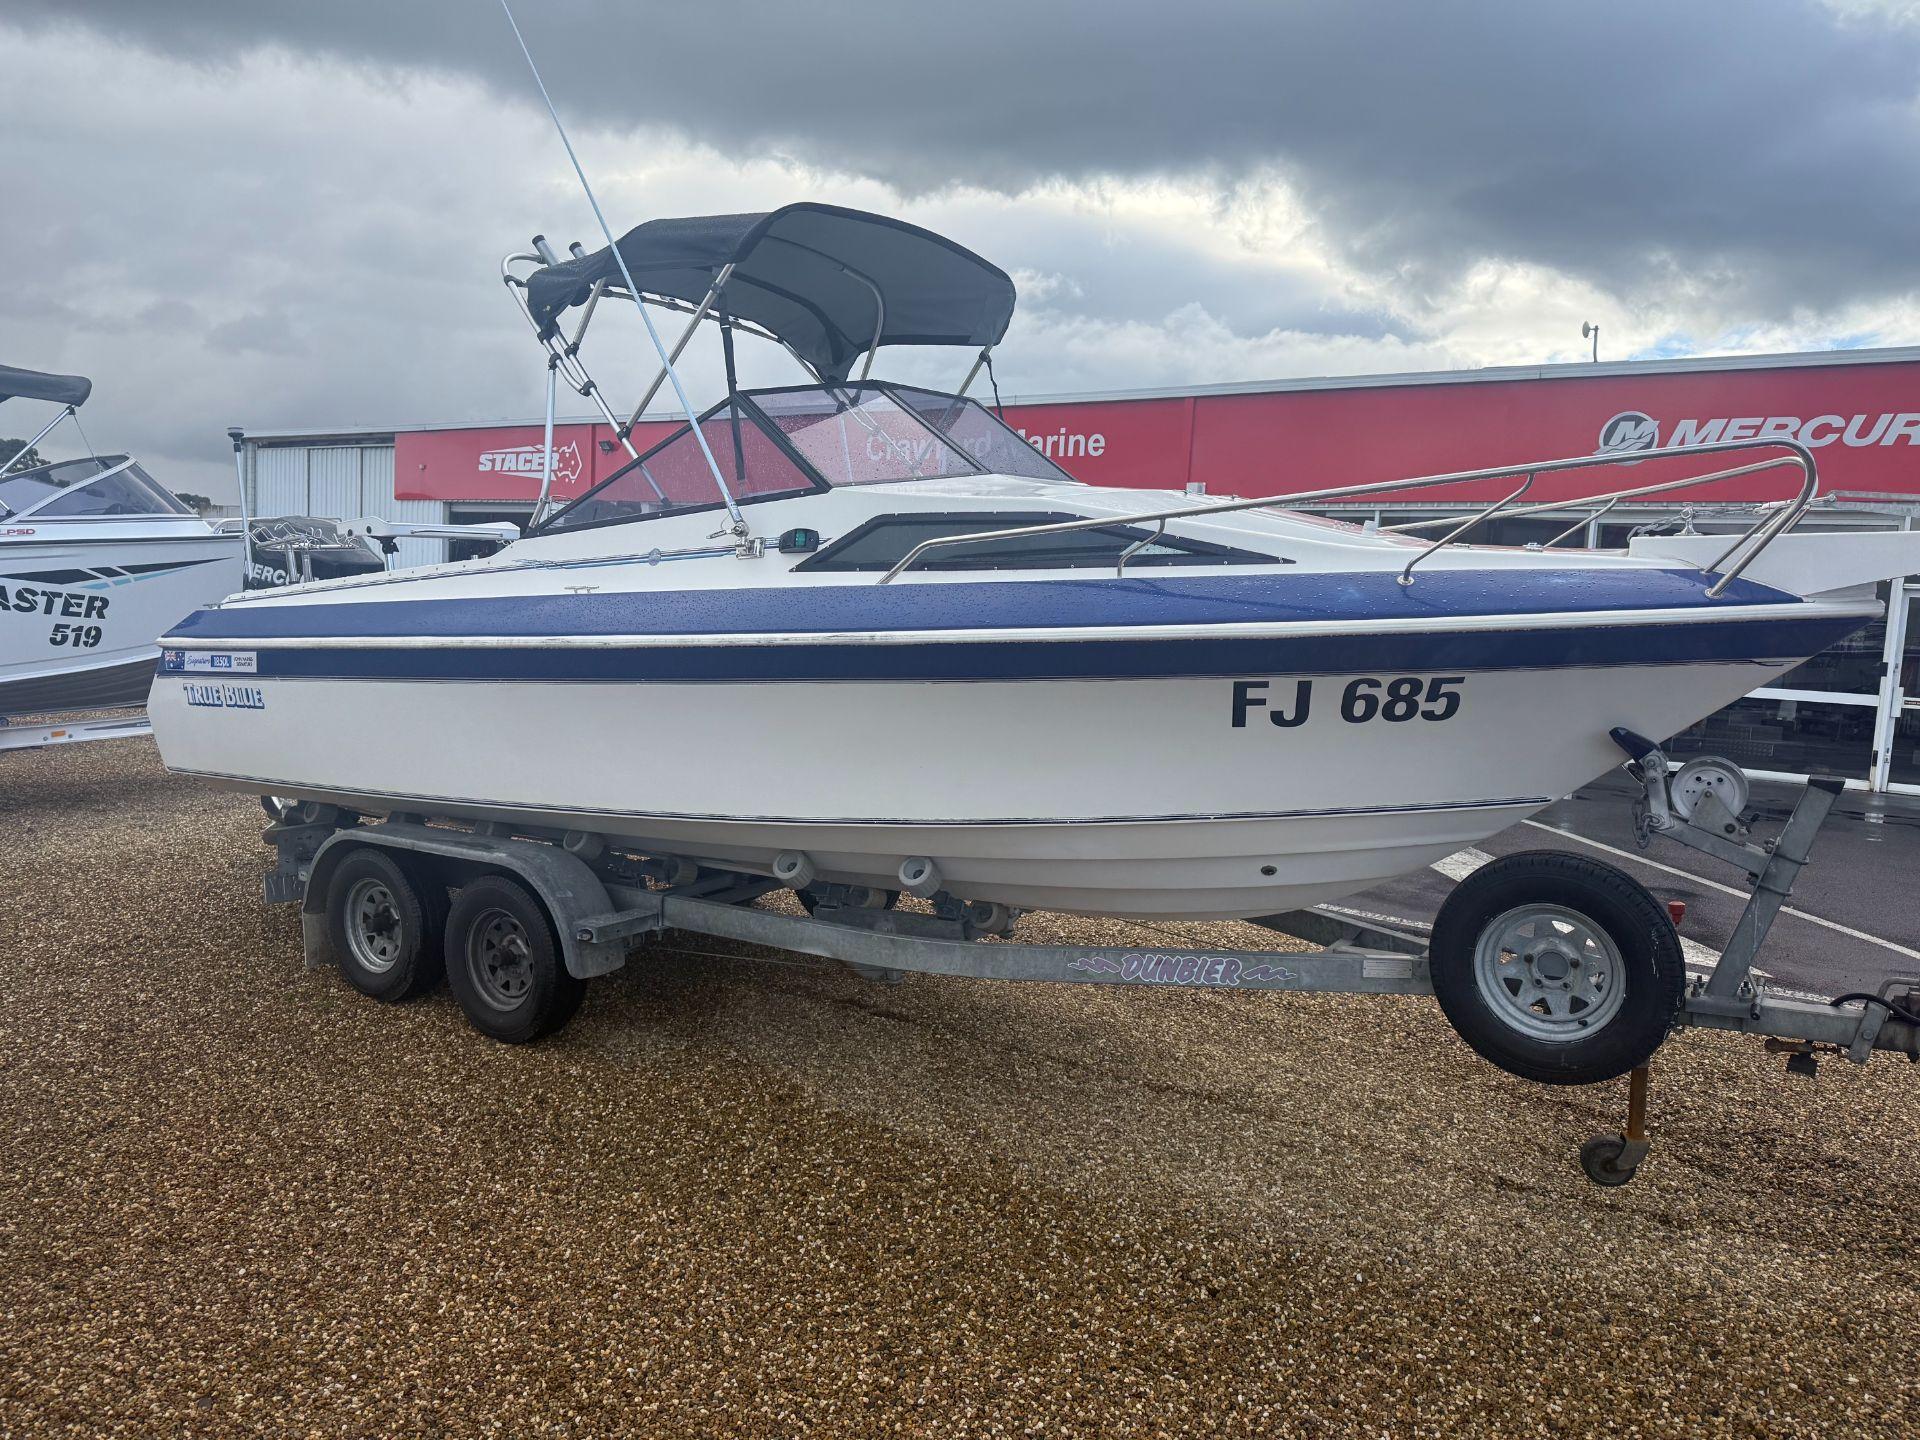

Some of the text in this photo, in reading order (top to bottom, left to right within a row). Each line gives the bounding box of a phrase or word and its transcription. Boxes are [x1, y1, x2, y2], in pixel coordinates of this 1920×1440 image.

[866, 430, 992, 463] Crawfrd
[49, 623, 103, 648] 519
[183, 683, 265, 710] TRUE BLUE
[1231, 676, 1466, 728] FJ 685
[1120, 953, 1243, 986] DUNBIER
